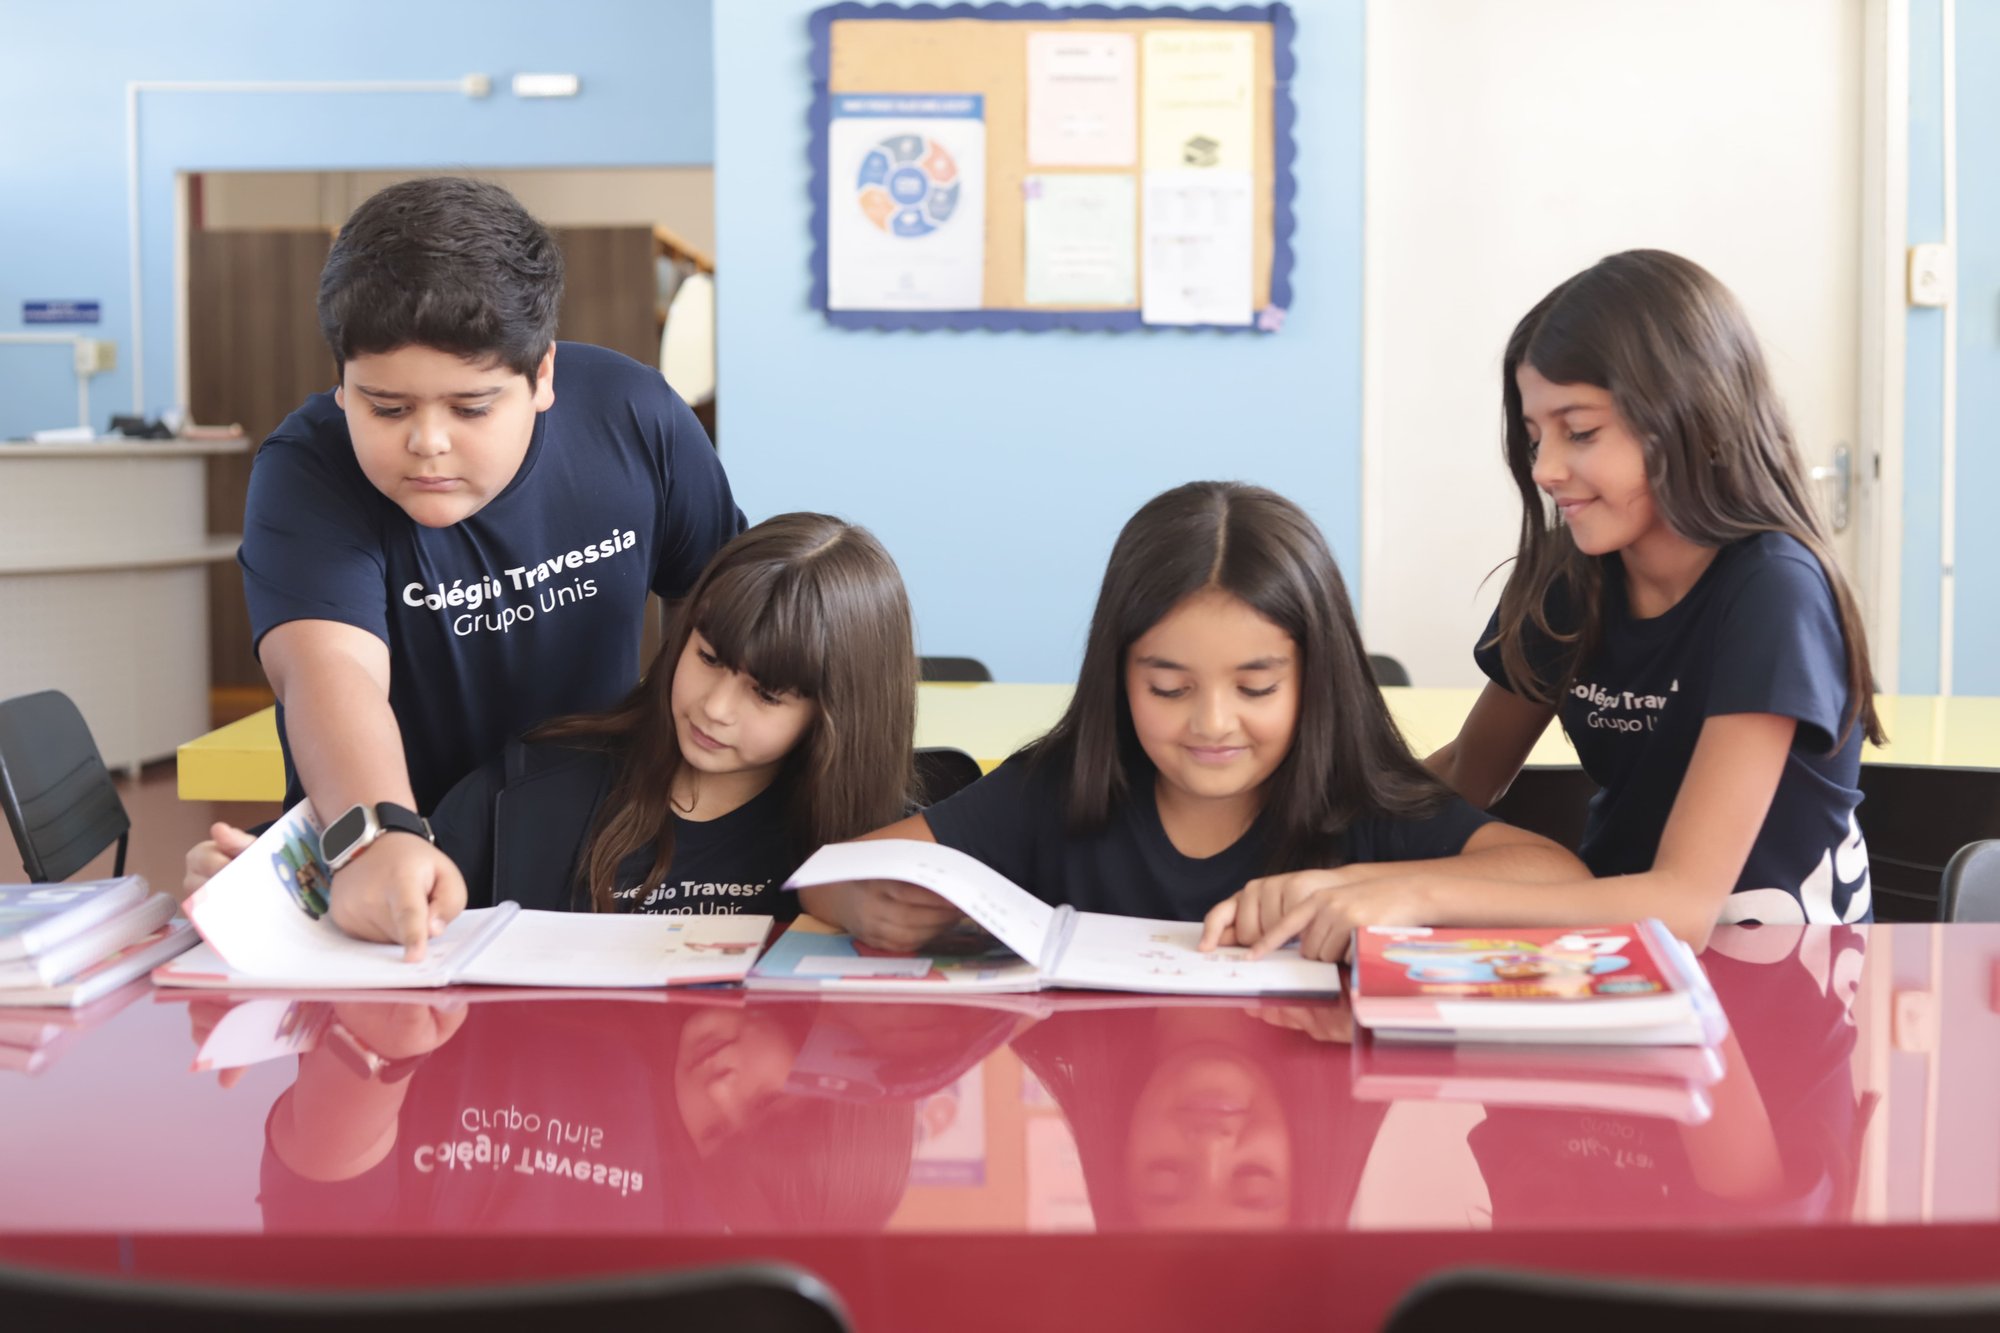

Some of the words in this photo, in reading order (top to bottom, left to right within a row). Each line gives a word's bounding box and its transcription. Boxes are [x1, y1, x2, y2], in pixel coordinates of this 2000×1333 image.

[402, 575, 501, 611] Colégio
[504, 528, 637, 591] Travessia
[453, 604, 535, 637] Grupo
[539, 577, 598, 613] Unis
[1587, 711, 1643, 734] Grupo
[608, 883, 677, 905] olégio
